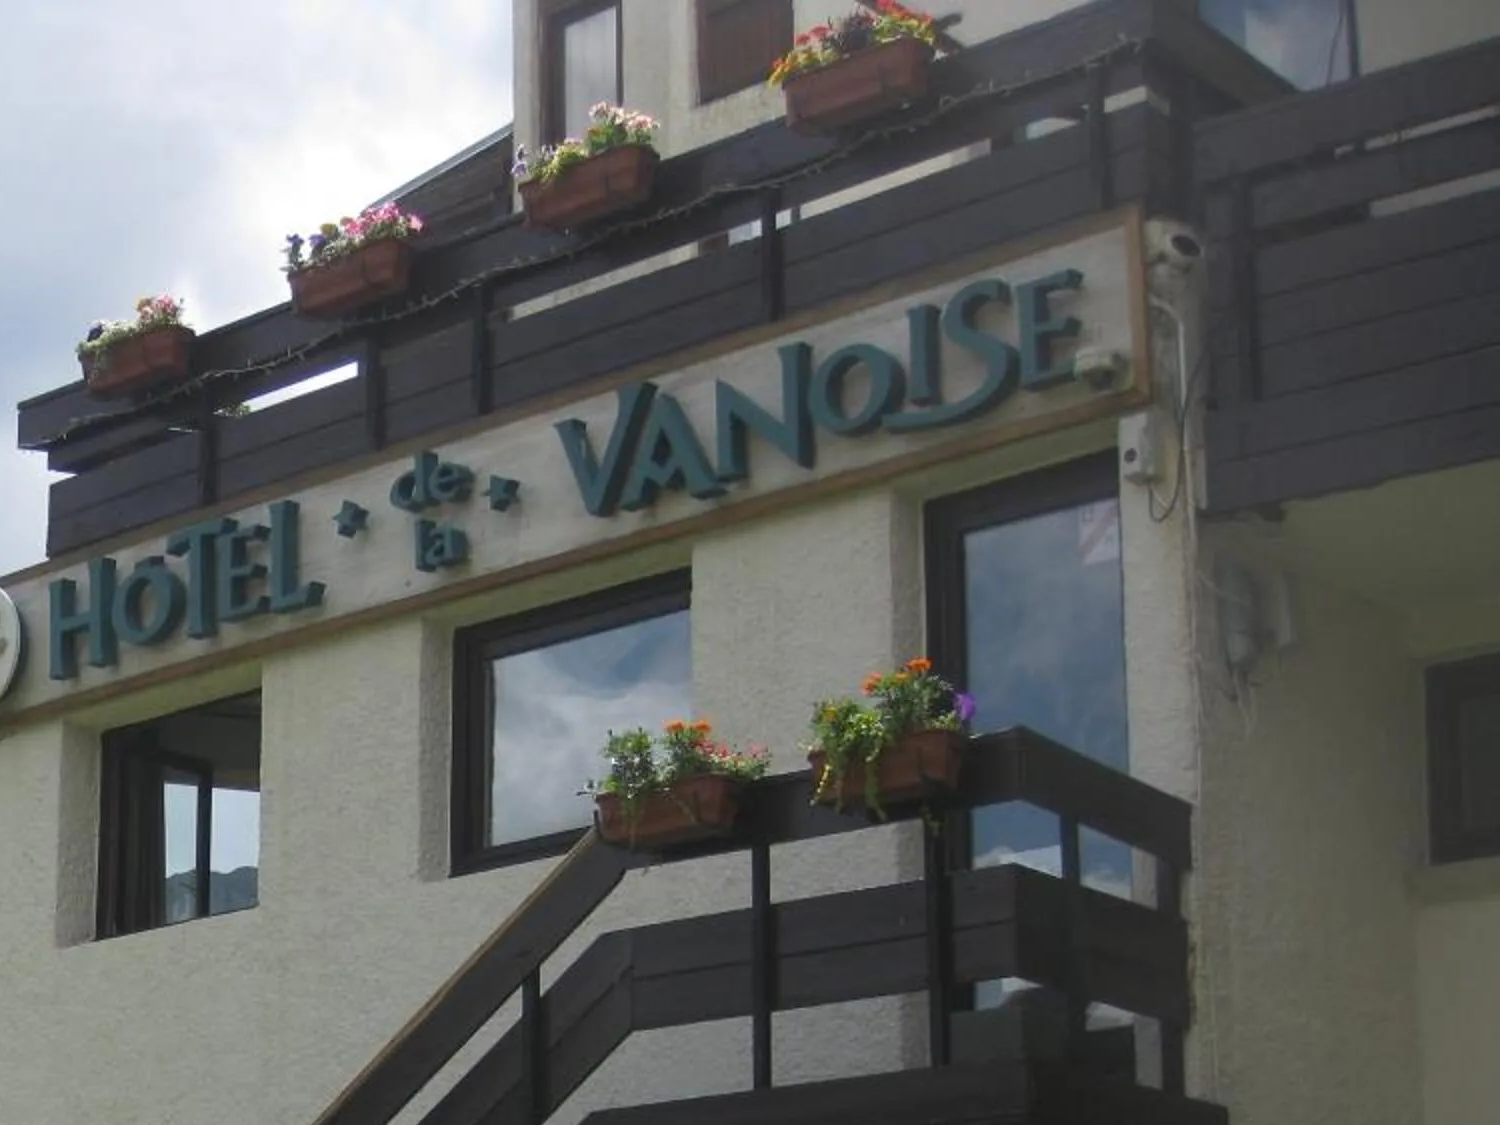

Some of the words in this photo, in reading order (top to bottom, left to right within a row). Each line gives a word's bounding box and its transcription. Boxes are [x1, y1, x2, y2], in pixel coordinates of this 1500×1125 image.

[390, 450, 474, 512] de
[553, 268, 1084, 518] VANOISE
[415, 519, 472, 572] la
